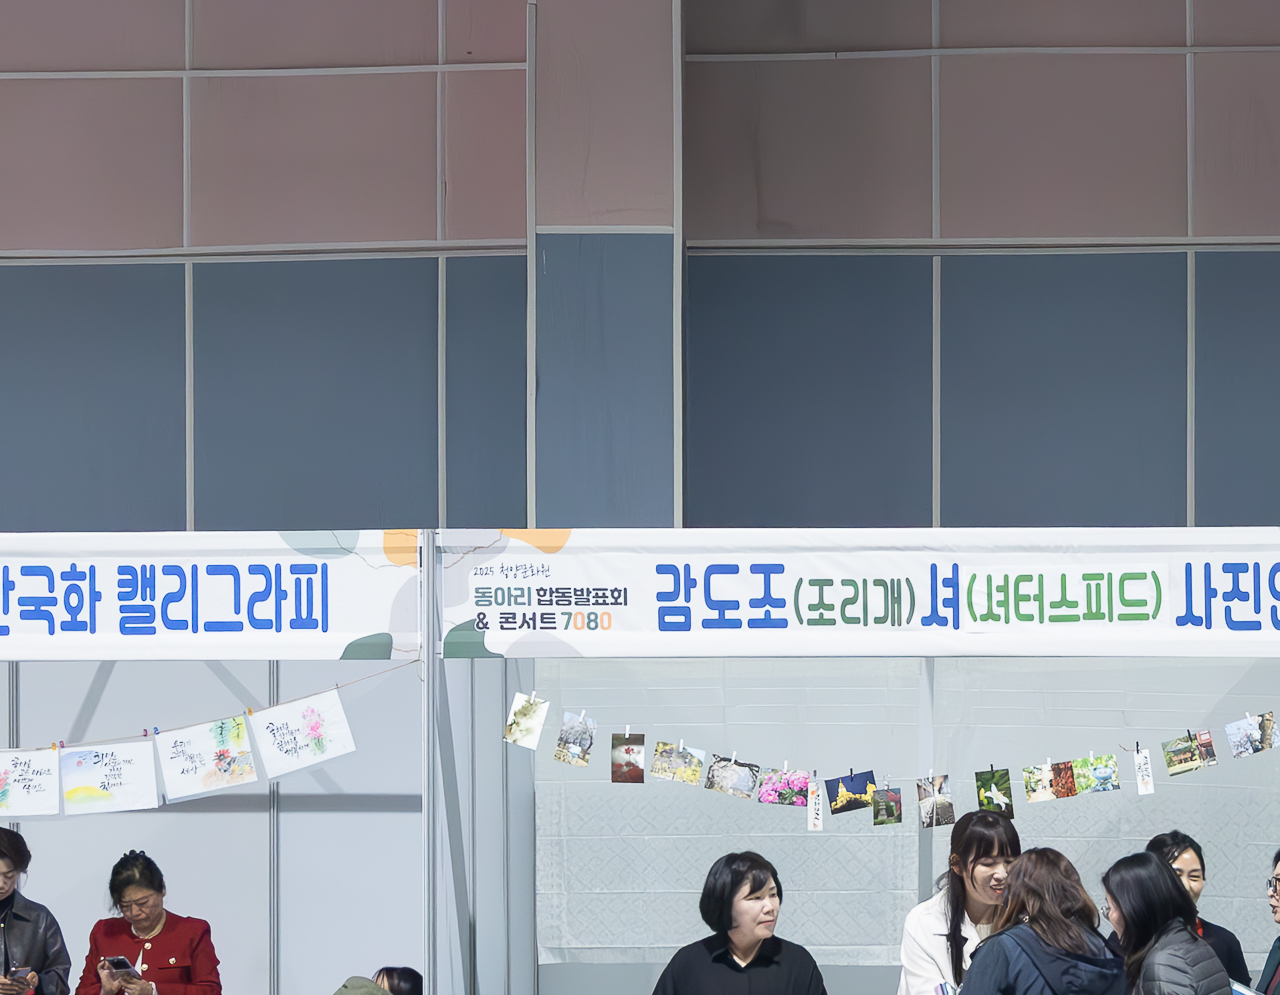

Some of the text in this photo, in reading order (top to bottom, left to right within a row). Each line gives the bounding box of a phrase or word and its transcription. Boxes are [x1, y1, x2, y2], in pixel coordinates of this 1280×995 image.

[474, 563, 551, 579] 2025 청양문화원
[117, 563, 328, 636] 캘리그라피
[474, 587, 627, 606] 동아리 합동발표회
[476, 611, 612, 630] & 콘서트 7080
